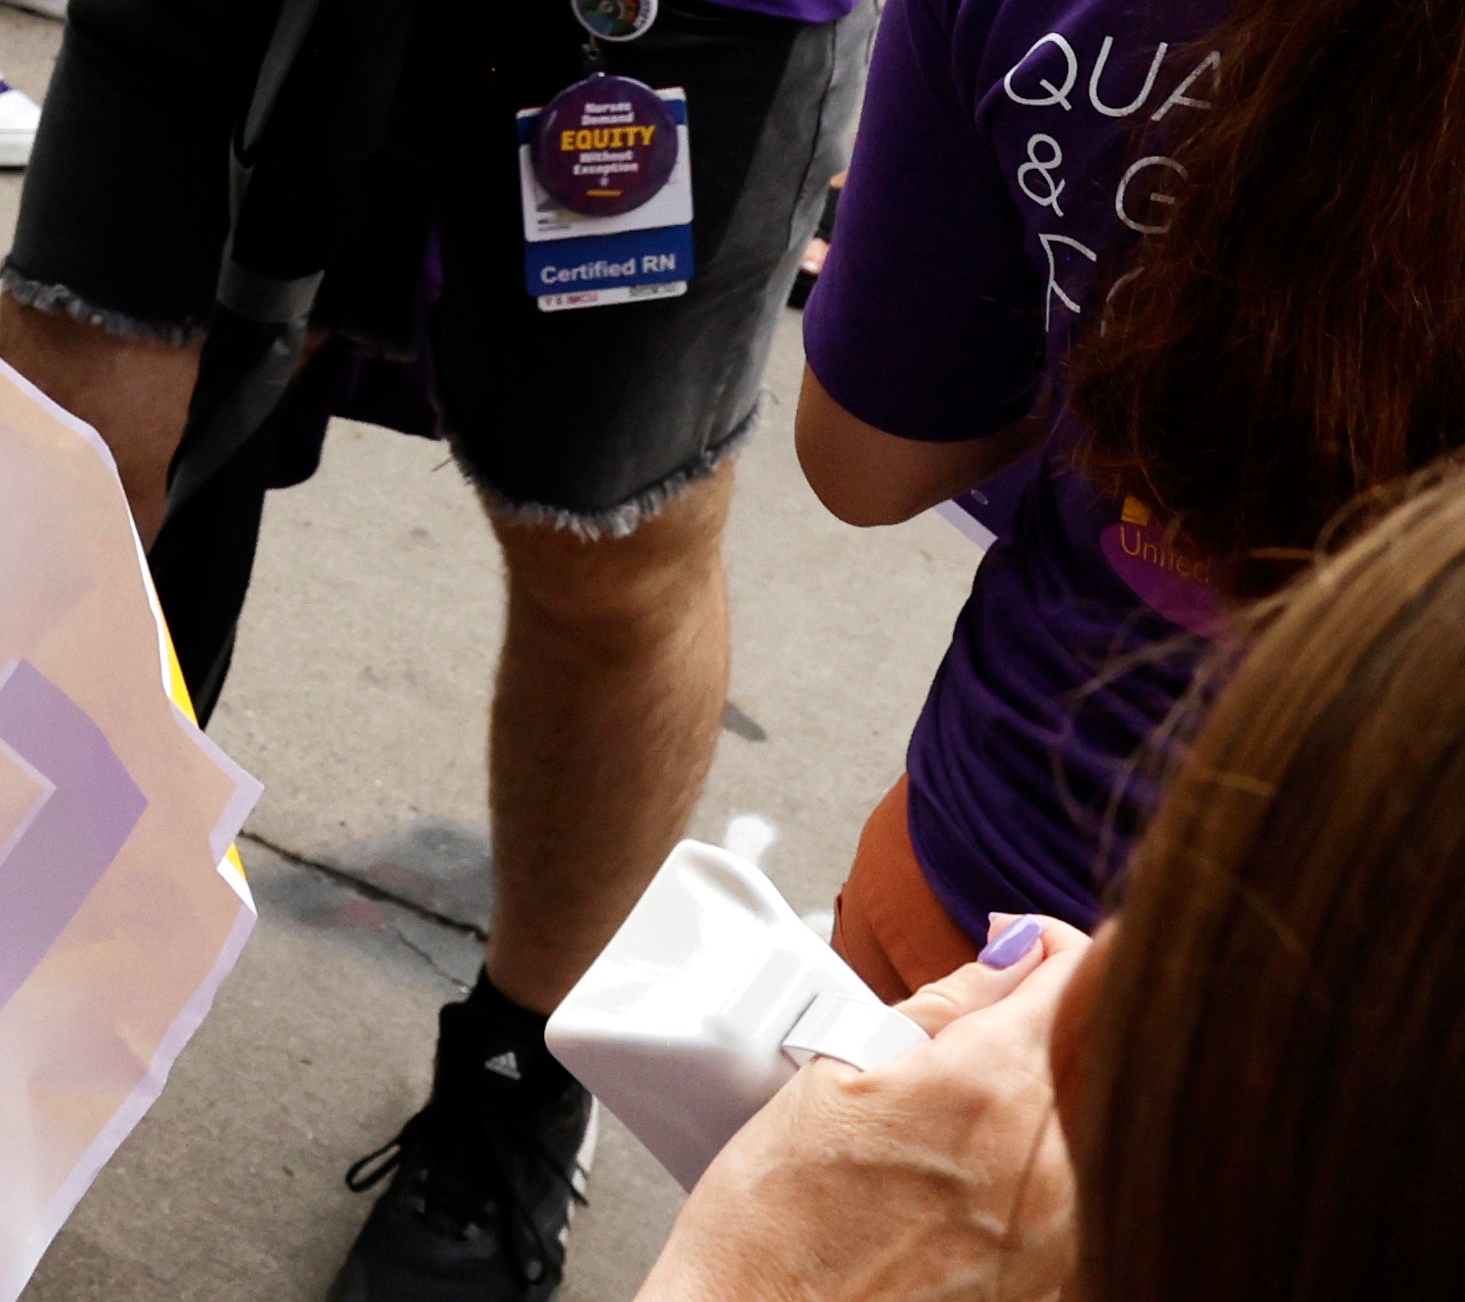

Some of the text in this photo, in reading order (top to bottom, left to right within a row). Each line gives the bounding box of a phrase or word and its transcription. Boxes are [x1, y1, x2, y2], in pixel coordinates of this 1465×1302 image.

[559, 124, 657, 151] EQUITY
[1016, 132, 1066, 218] &
[540, 252, 677, 285] Certified RN
